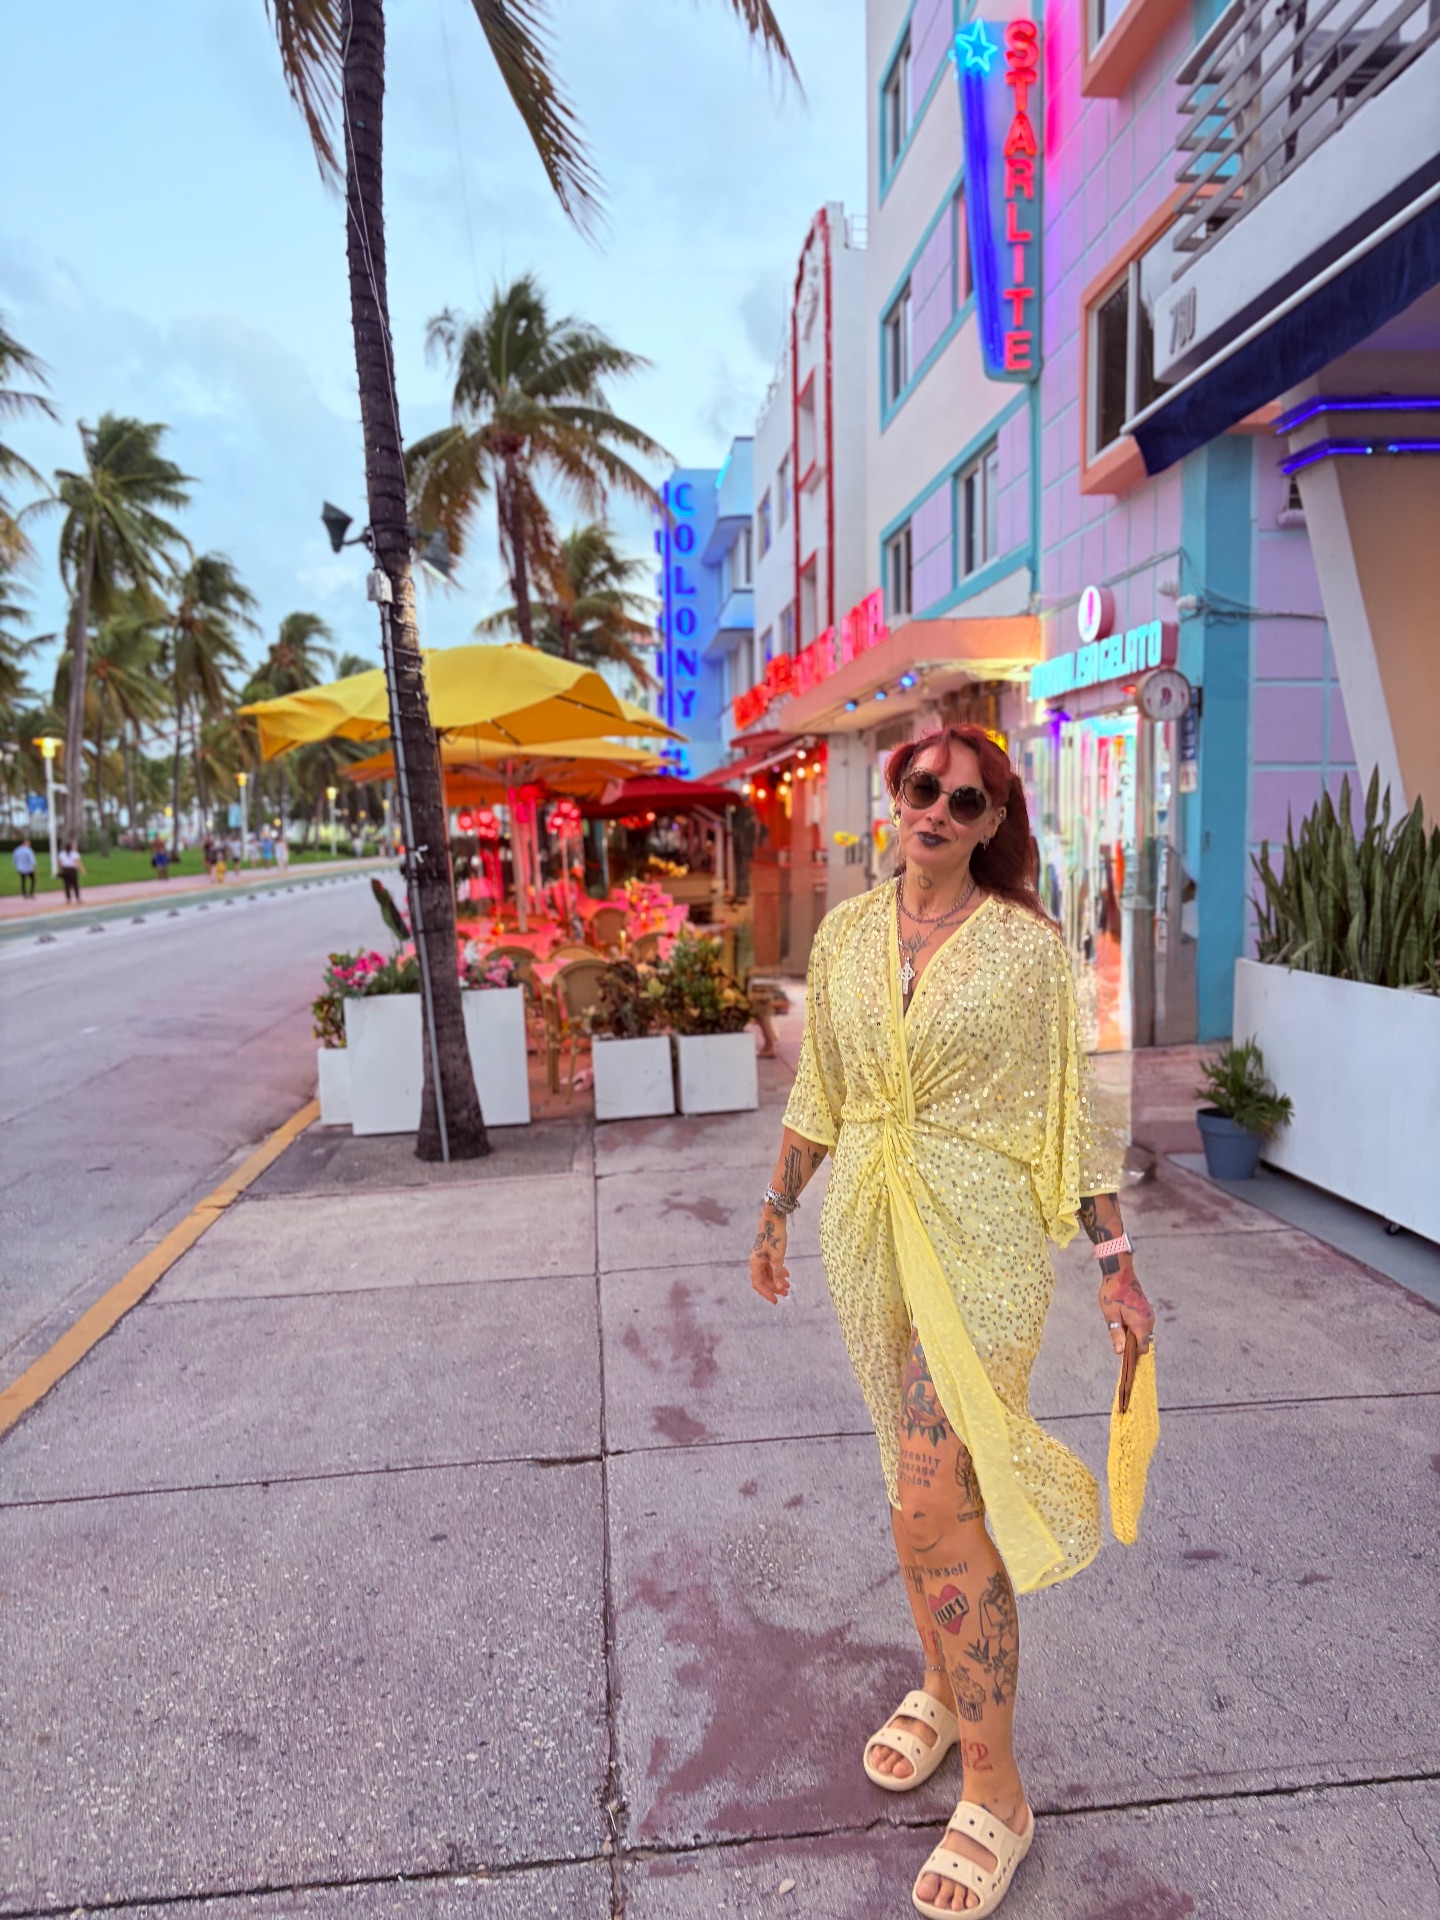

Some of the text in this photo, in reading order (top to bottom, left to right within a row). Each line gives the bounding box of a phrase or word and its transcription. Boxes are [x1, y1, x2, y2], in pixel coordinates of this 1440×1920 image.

[1003, 20, 1039, 371] STARLITE
[674, 482, 698, 718] COLONY
[1099, 620, 1163, 682] GELATO
